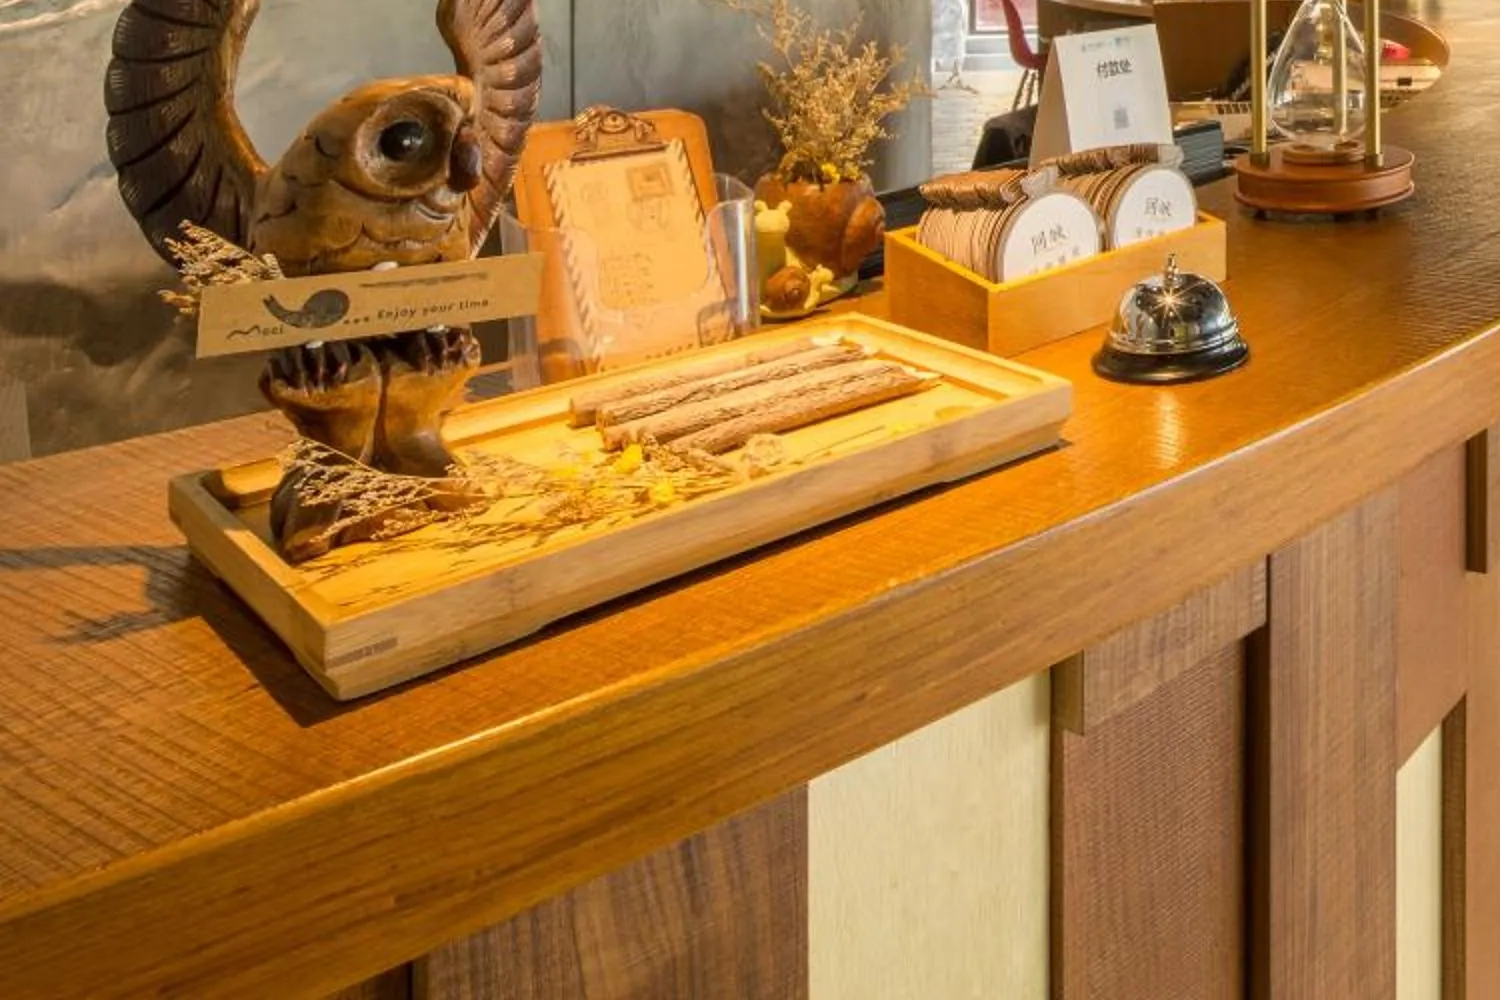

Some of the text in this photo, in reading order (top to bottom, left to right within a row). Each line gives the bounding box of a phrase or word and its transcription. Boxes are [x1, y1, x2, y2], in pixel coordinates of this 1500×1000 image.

[377, 307, 417, 321] Enjoy
[422, 303, 456, 318] your
[459, 299, 489, 311] time
